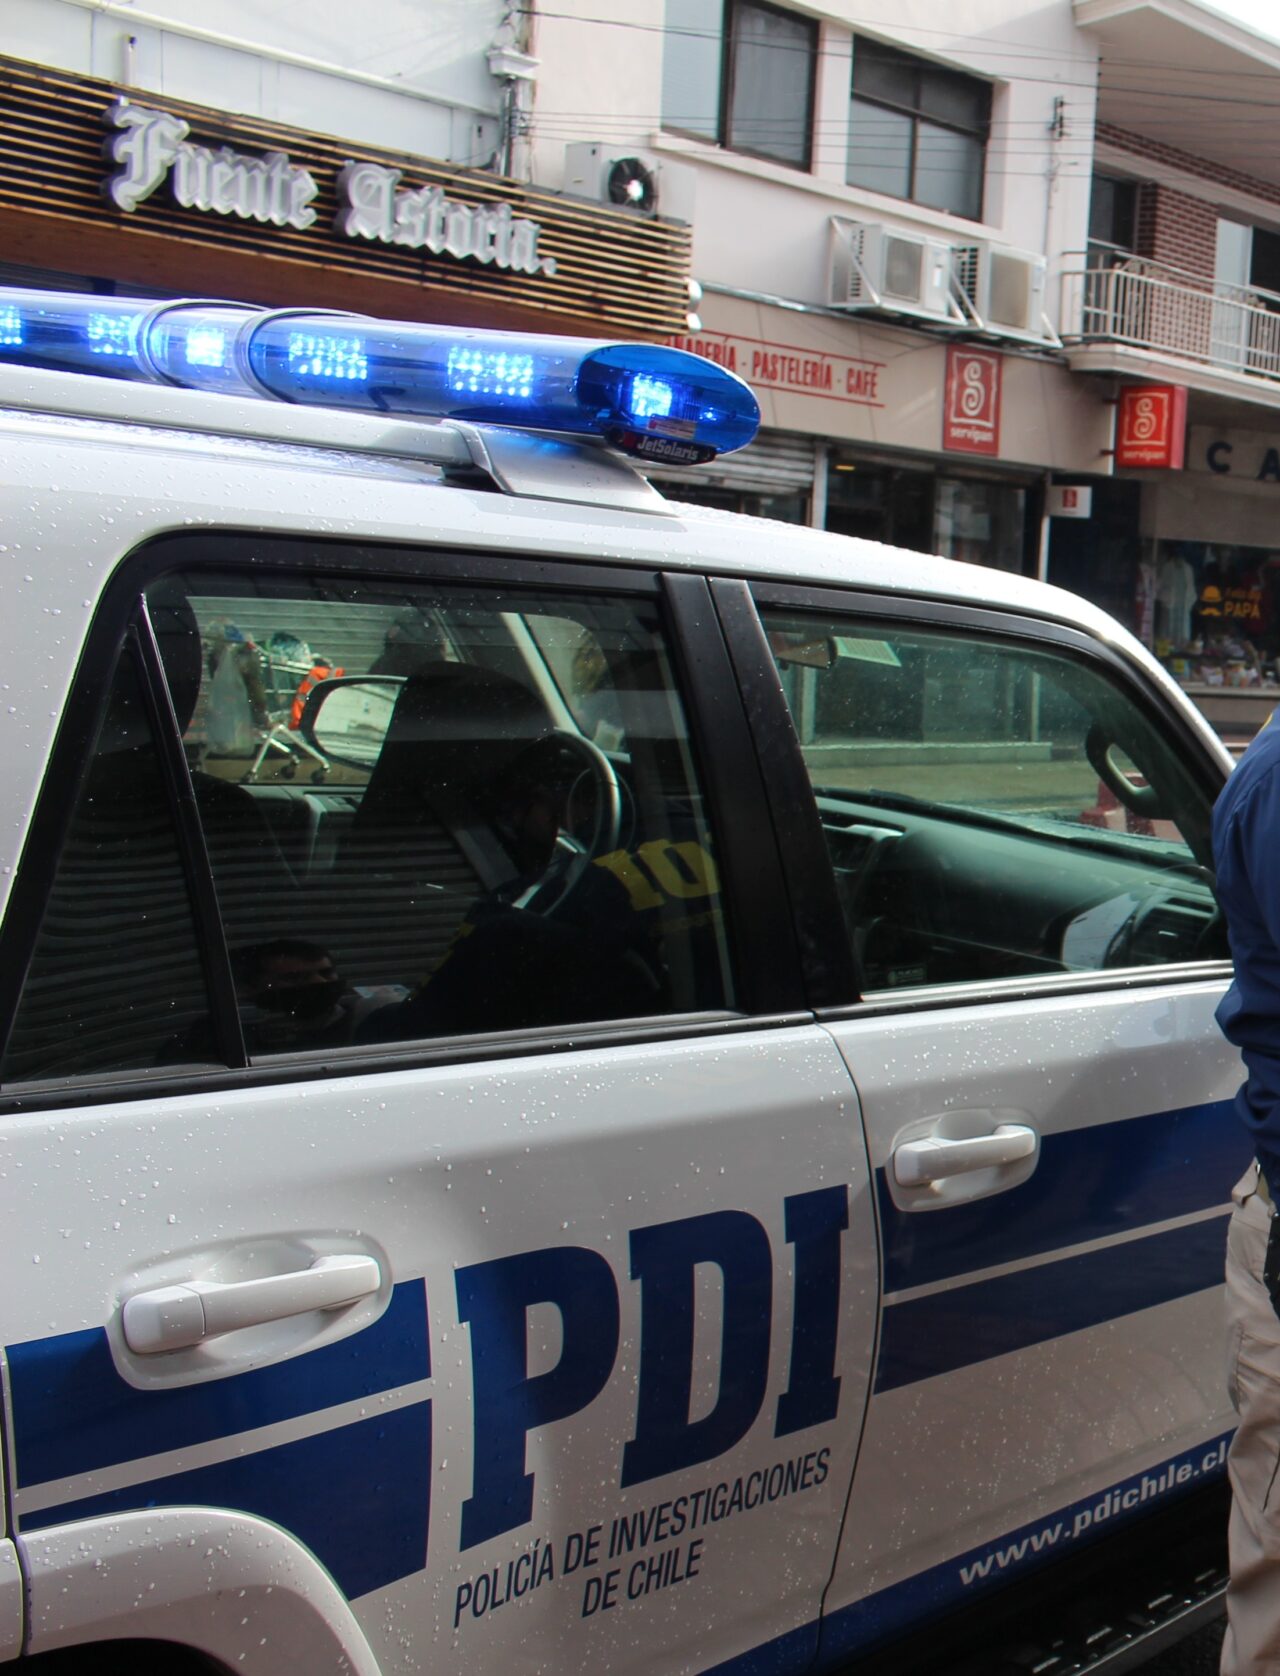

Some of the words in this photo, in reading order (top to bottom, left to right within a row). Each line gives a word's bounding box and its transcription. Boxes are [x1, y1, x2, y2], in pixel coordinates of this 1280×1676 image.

[110, 97, 319, 230] Fuente
[338, 160, 558, 277] Astoria.
[752, 353, 833, 391] PASTELERÍA
[847, 365, 878, 398] CAFÉ
[637, 435, 700, 461] JetSolaris
[950, 426, 994, 443] servipan
[454, 1183, 849, 1553] PDI
[453, 1538, 555, 1629] POLICÍA
[562, 1524, 603, 1575] DE
[607, 1447, 832, 1559] INVESTIGACIONES
[958, 1440, 1227, 1585] www.pdichile.cl
[580, 1568, 621, 1618] DE
[626, 1538, 705, 1600] CHILE
